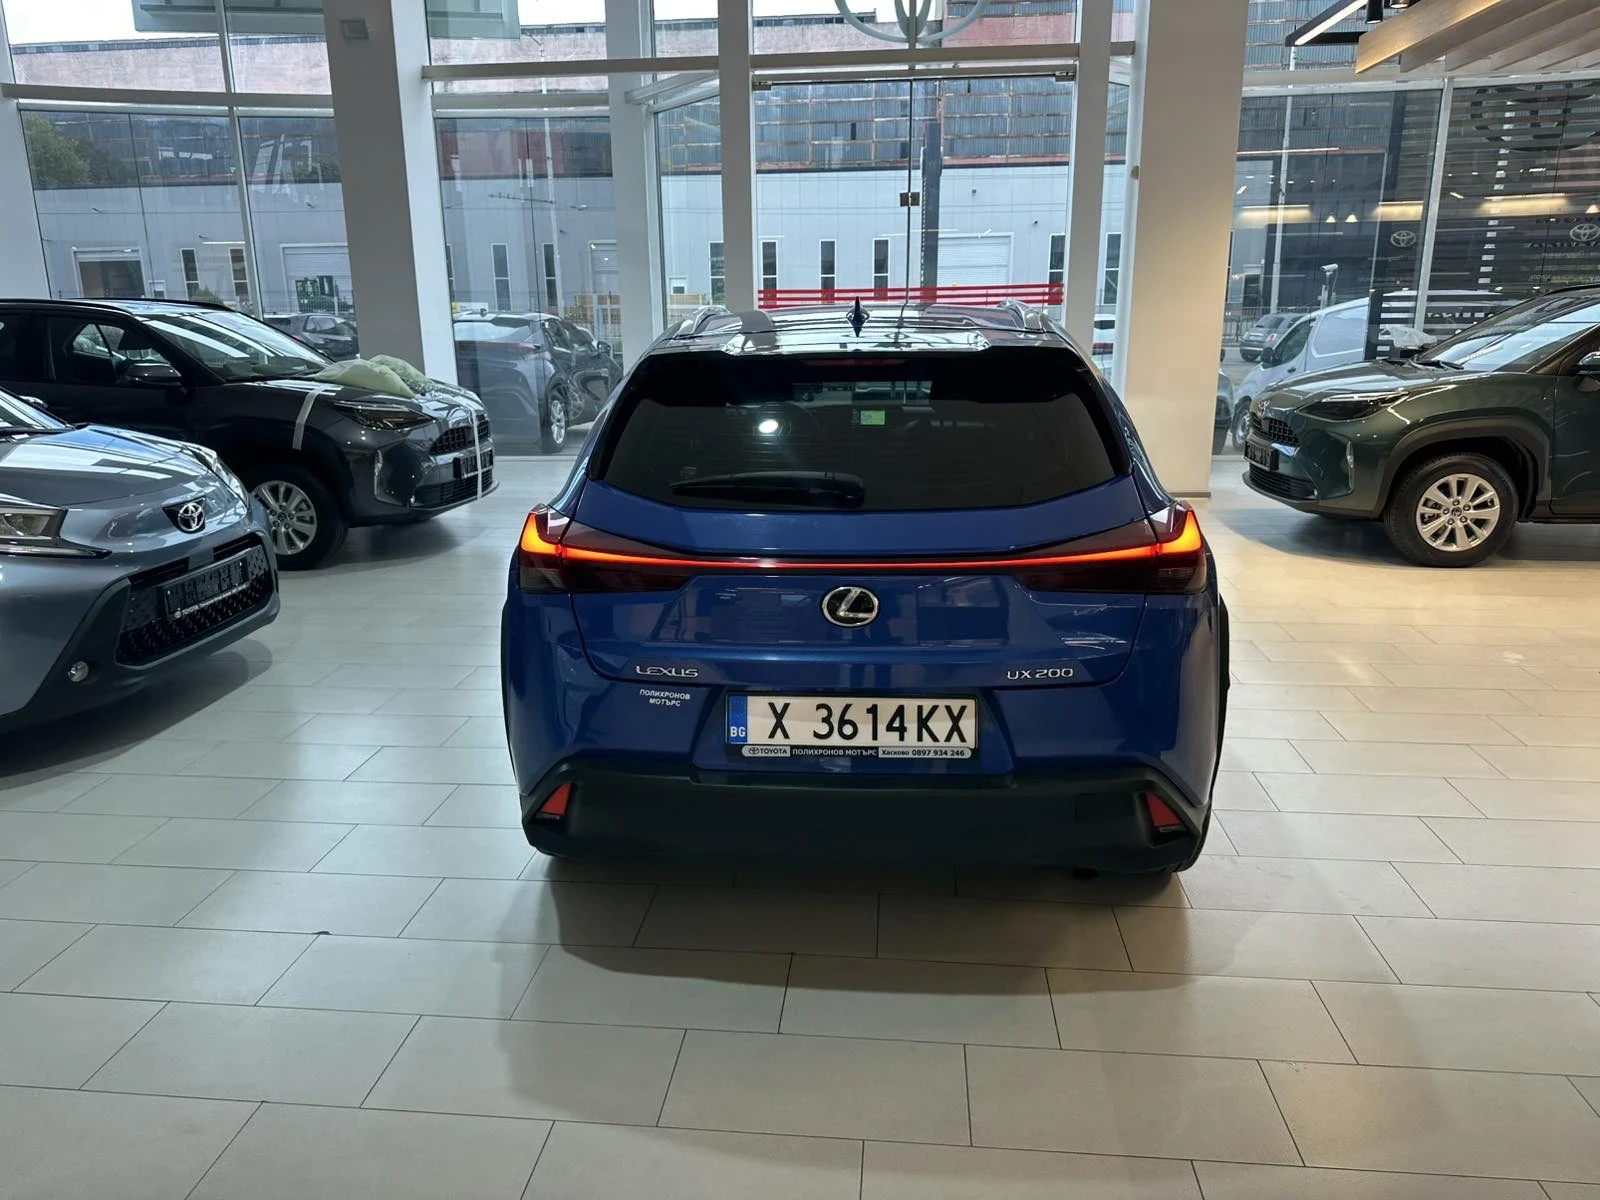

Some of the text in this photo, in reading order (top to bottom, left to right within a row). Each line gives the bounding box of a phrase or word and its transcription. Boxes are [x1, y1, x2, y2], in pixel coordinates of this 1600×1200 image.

[636, 665, 699, 678] LEXUS
[1007, 668, 1074, 680] UX 200
[639, 689, 691, 700] ПОЛИХРОНОВ
[649, 698, 681, 707] МОТЪРС
[729, 726, 747, 738] BG
[792, 748, 877, 756] ПОЛИХРОНОВ МОТЪРС
[911, 748, 932, 757] 0897
[933, 748, 948, 757] 934
[950, 749, 965, 757] 246
